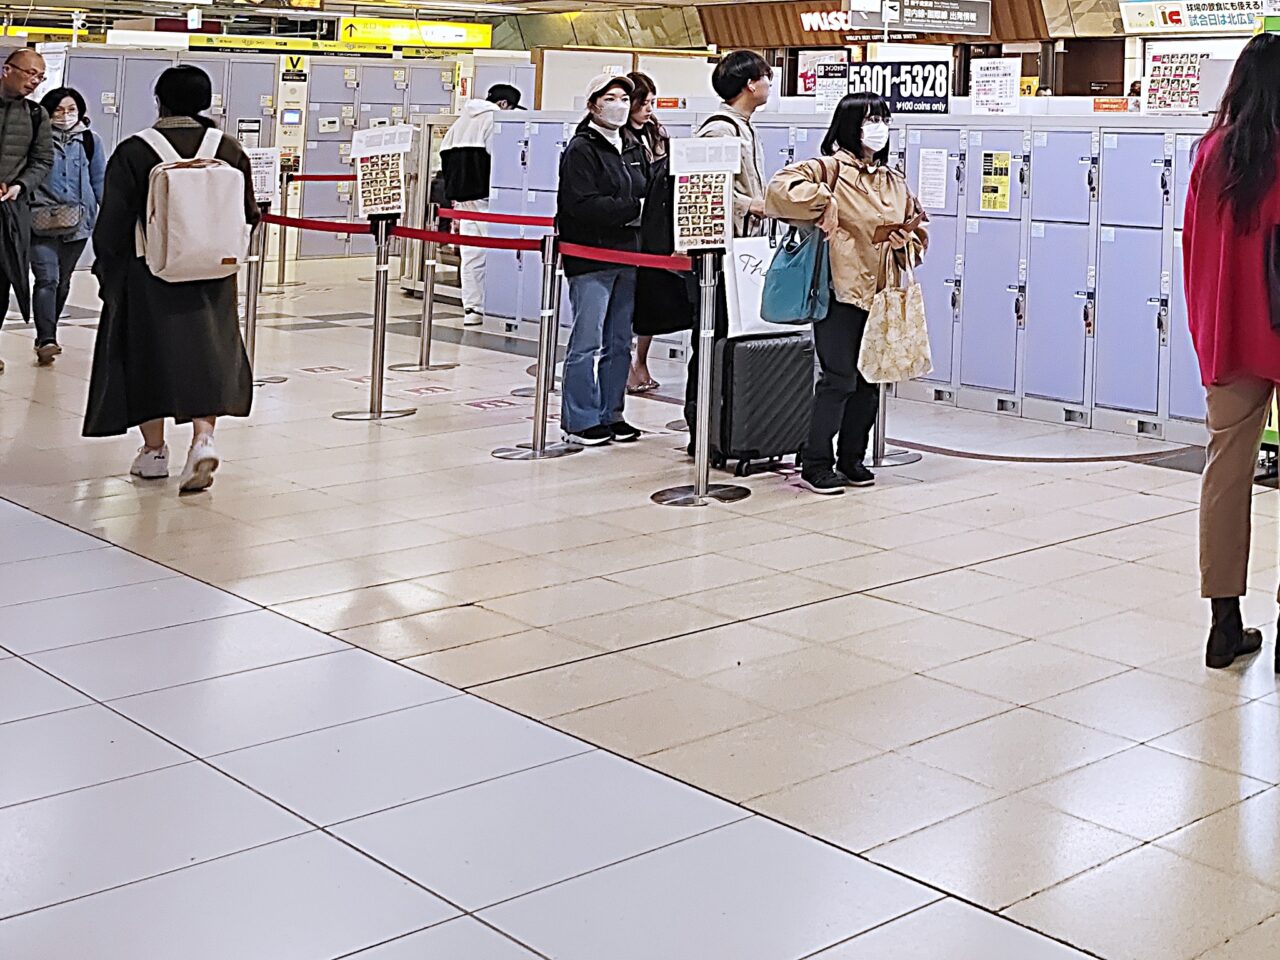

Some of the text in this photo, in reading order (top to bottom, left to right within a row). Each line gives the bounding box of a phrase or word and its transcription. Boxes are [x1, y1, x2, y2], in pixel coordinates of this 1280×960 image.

[289, 56, 302, 69] V
[914, 101, 930, 111] coins
[932, 101, 946, 112] only
